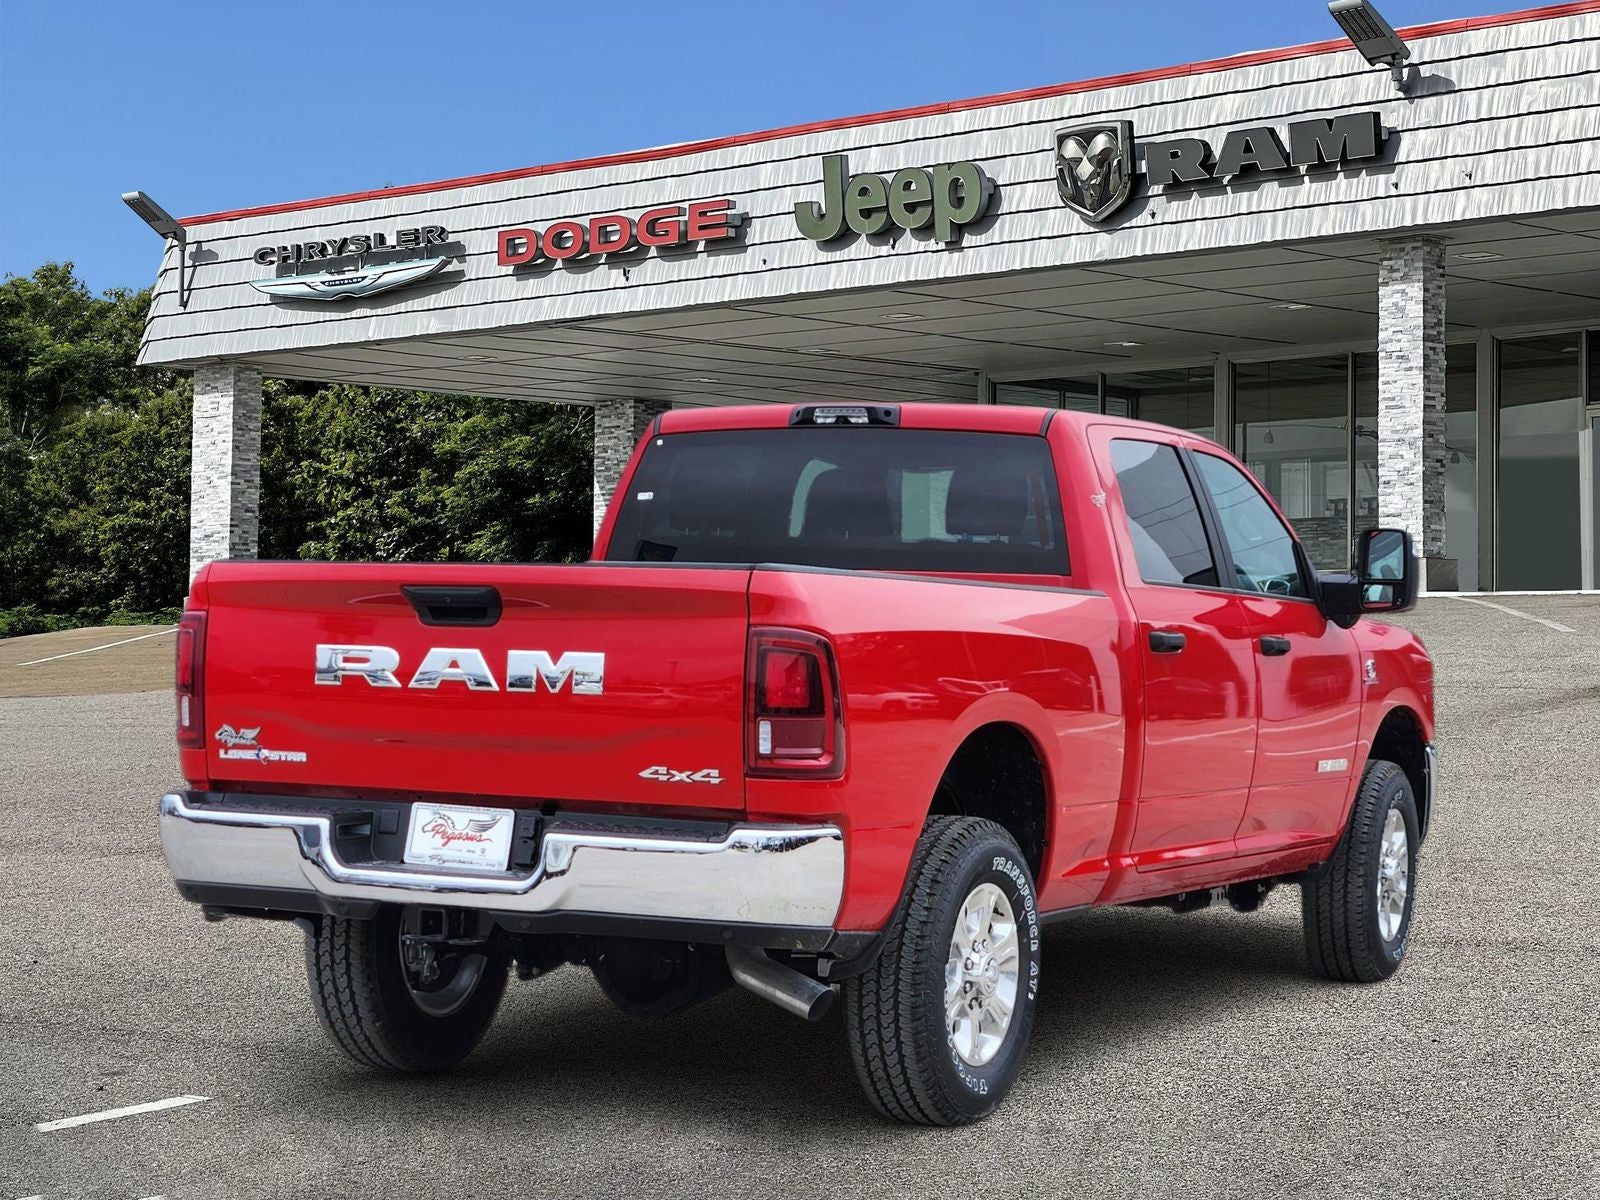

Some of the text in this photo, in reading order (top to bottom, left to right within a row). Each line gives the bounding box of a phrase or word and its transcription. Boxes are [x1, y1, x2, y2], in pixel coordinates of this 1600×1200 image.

[1145, 111, 1382, 187] RAM
[794, 154, 990, 243] Jeep
[253, 225, 449, 266] CHRYSLER
[497, 199, 737, 267] DODGE
[314, 643, 606, 696] RAM
[267, 750, 307, 762] STAR
[638, 766, 725, 784] 4x4
[431, 822, 493, 848] Pegasus
[991, 856, 1040, 952] TRANSFORCE
